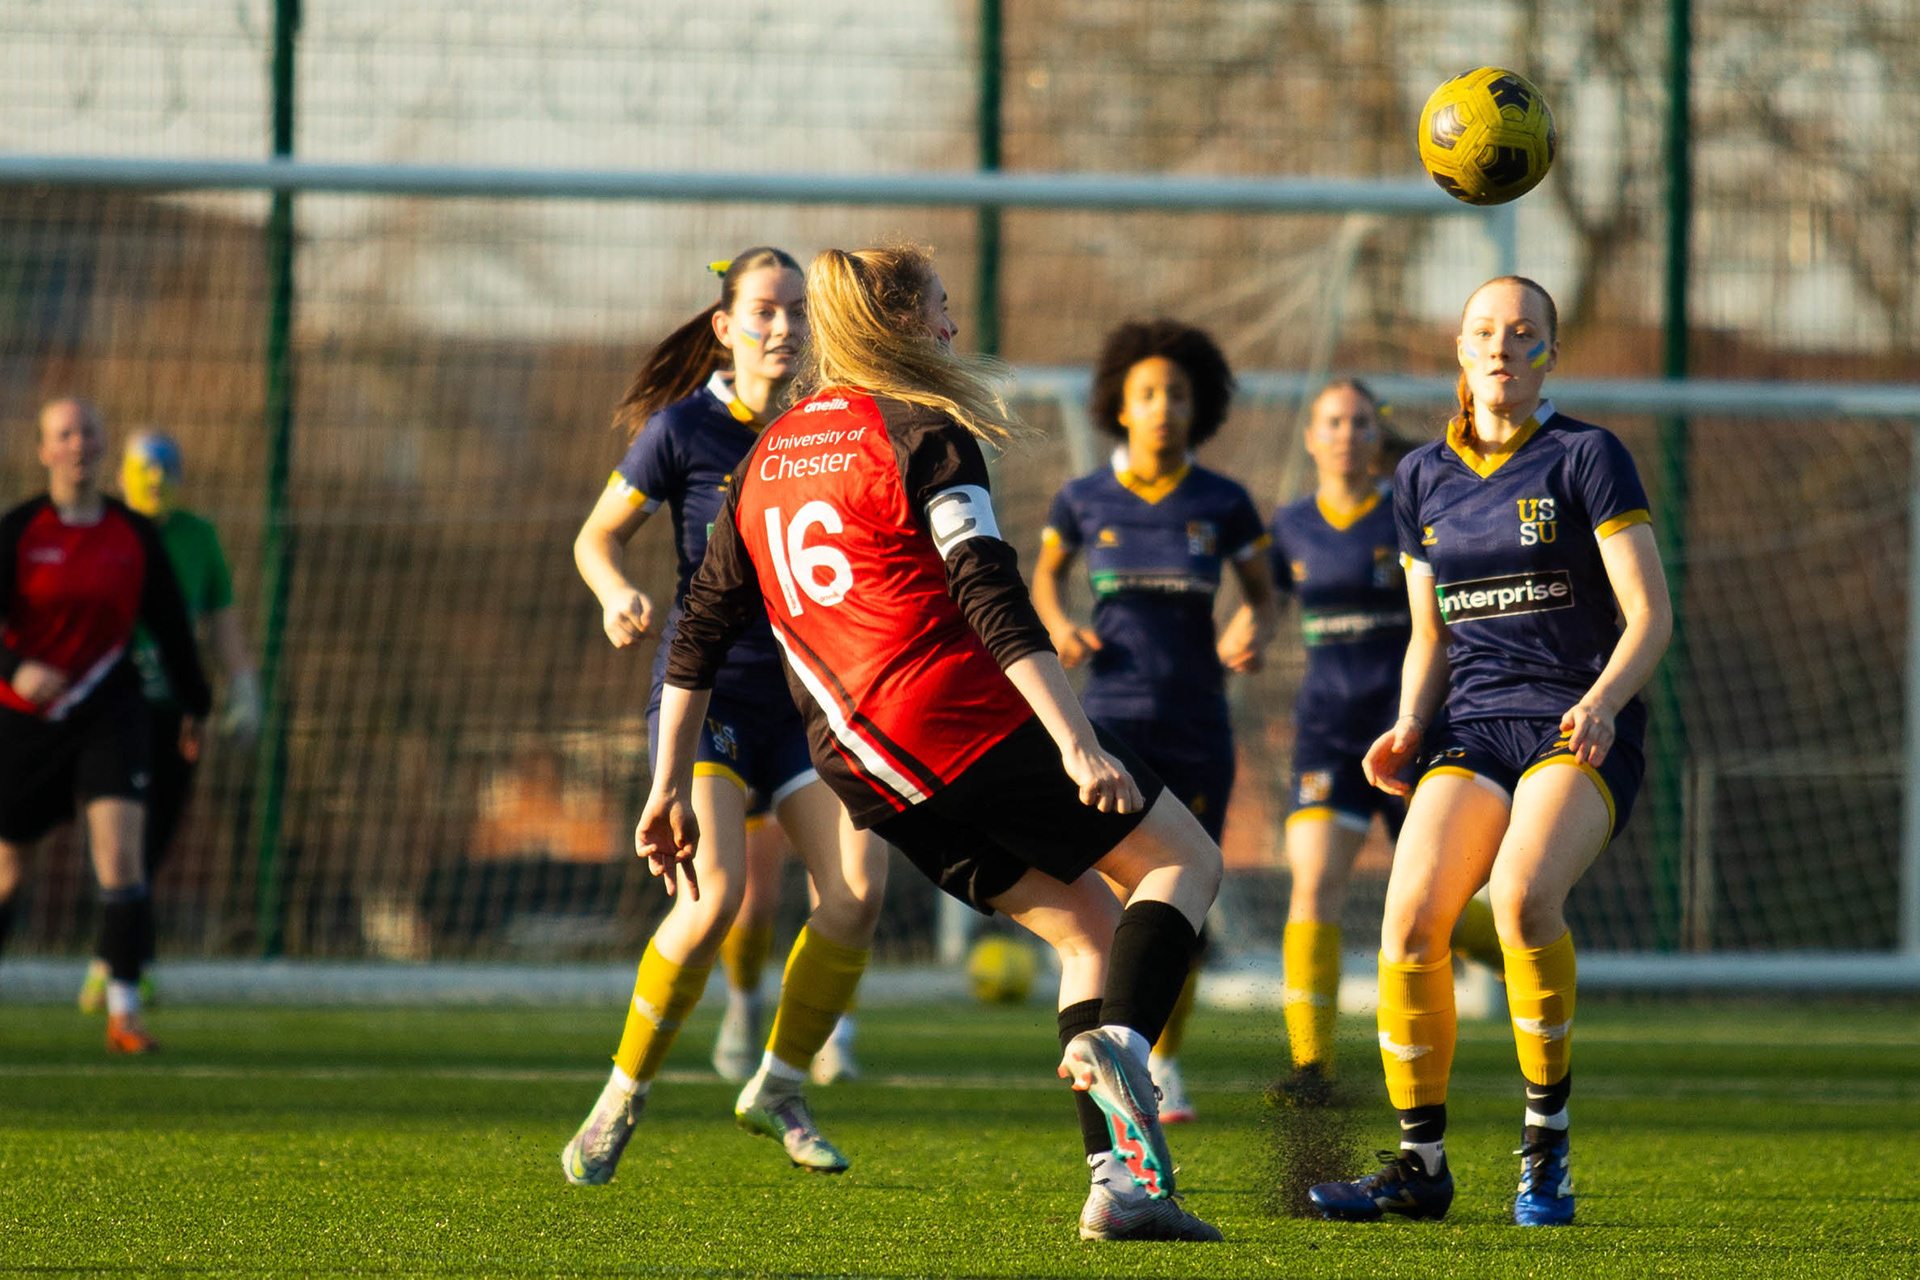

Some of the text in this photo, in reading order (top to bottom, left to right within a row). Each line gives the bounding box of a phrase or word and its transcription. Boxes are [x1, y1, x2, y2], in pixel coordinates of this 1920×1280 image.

[767, 426, 867, 451] University of
[760, 452, 857, 481] Chester
[1516, 498, 1555, 522] US
[1520, 521, 1557, 546] SU
[764, 500, 853, 617] 16
